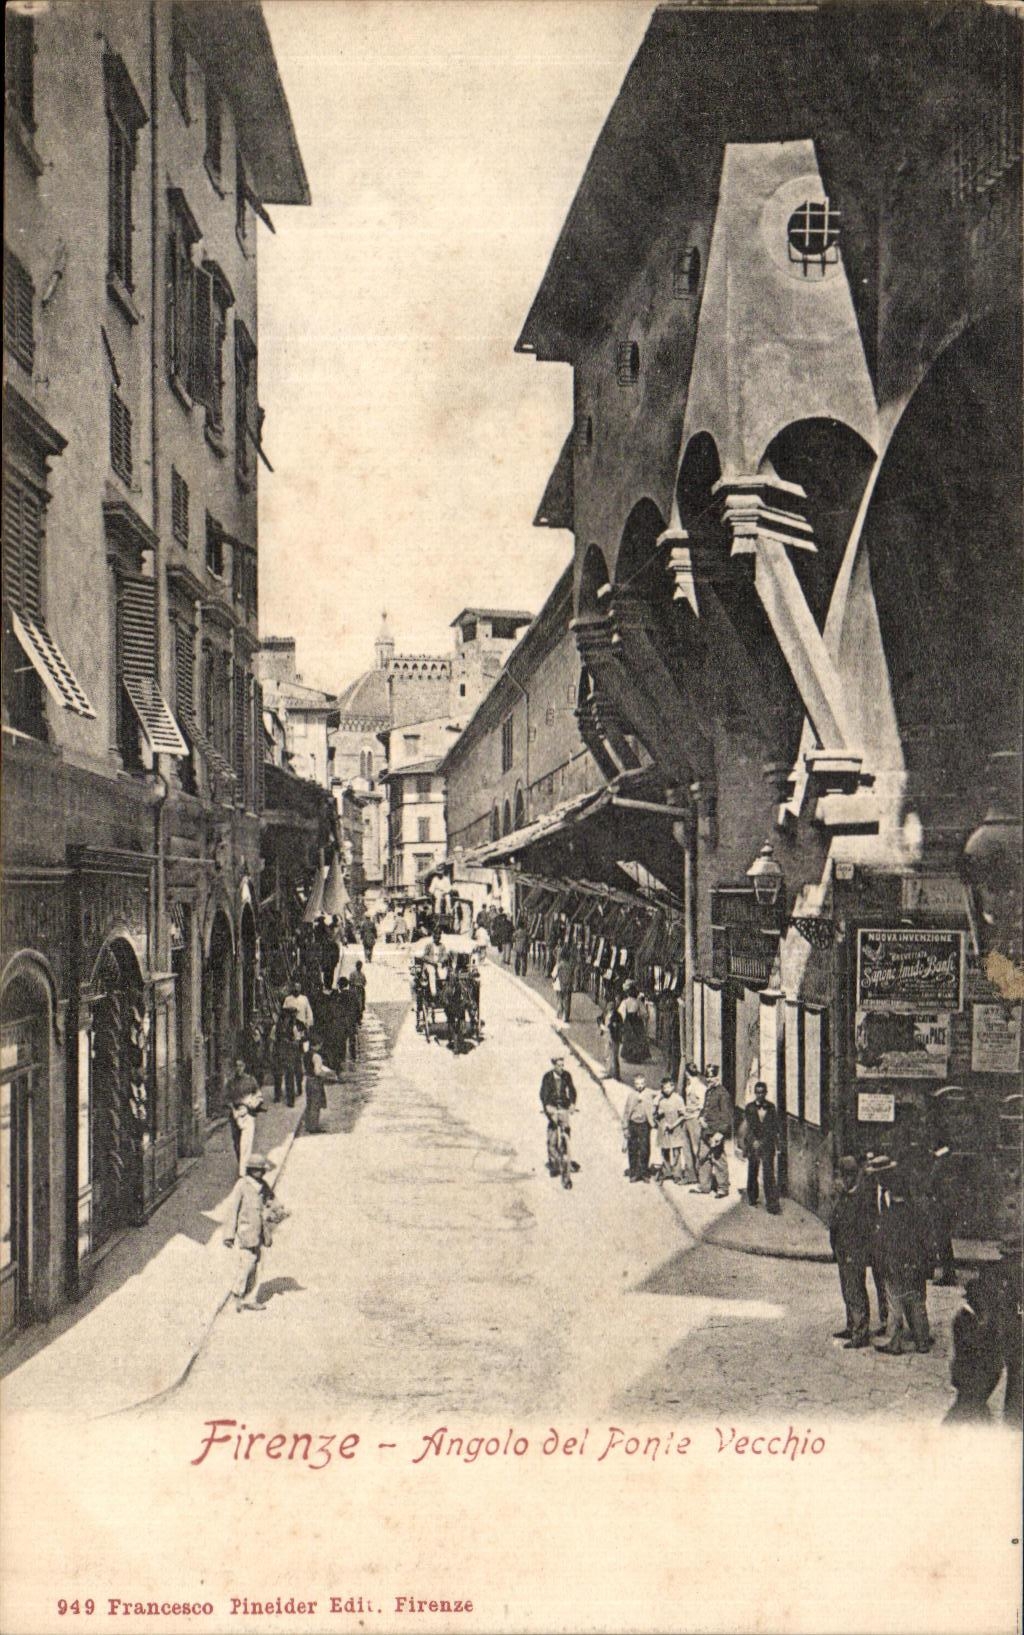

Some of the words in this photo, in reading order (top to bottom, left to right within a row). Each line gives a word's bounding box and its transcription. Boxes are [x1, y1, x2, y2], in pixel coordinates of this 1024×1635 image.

[868, 933, 897, 943] NUOVA
[899, 933, 953, 943] INVENZIONE
[861, 967, 896, 989] Sapone
